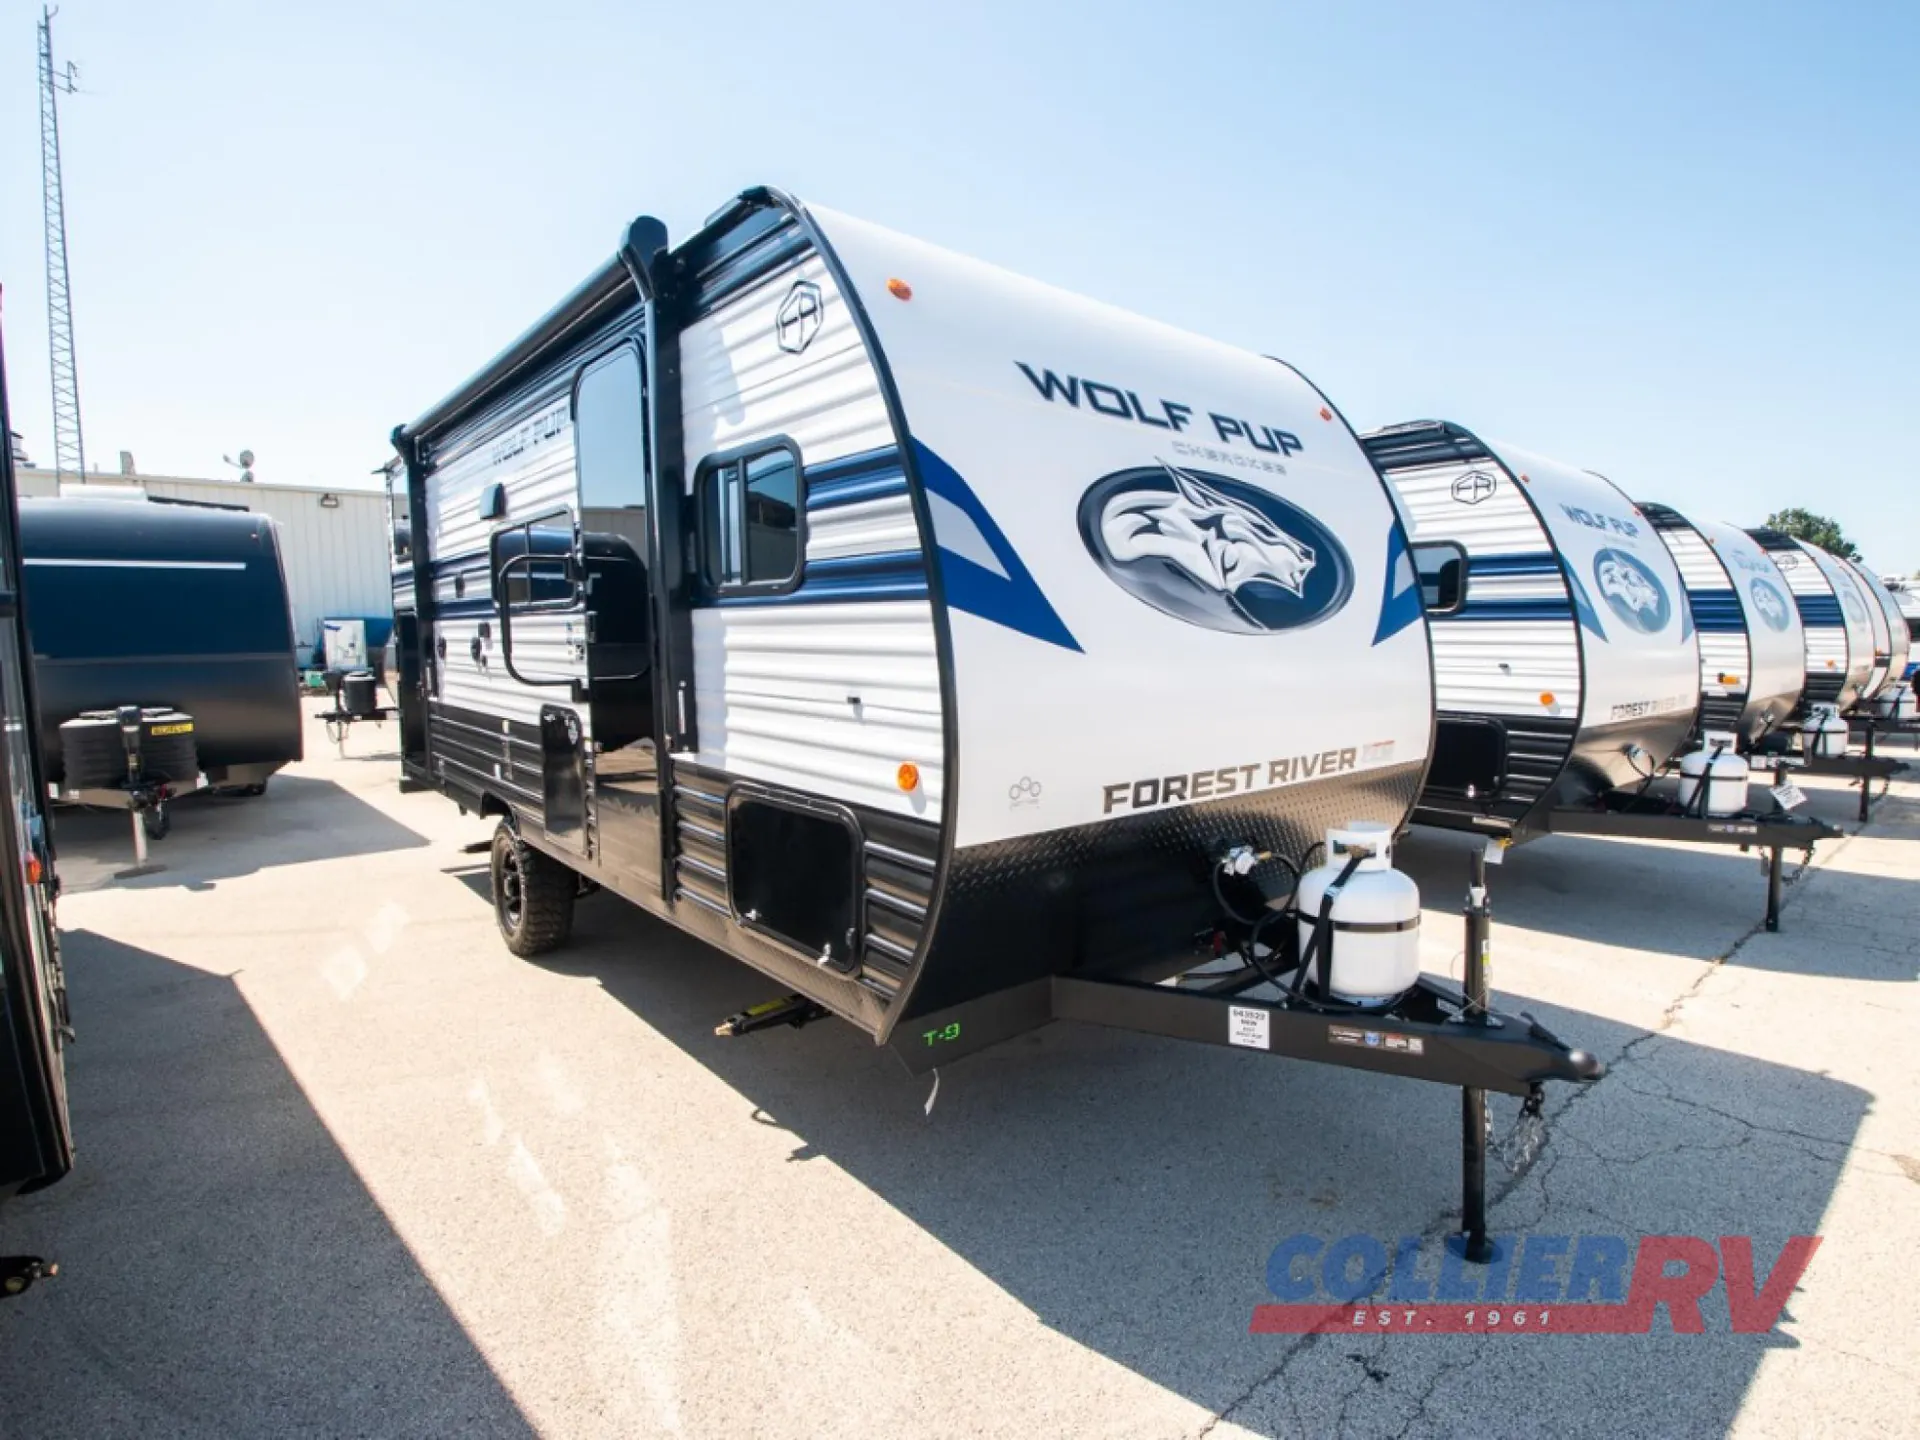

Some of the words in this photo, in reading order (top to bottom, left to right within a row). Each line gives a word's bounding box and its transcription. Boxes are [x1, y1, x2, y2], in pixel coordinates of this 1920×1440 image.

[1015, 360, 1193, 432] WOLF
[1208, 411, 1304, 457] PUP
[1560, 503, 1606, 530] WOLF
[1607, 516, 1639, 537] PUP
[1611, 700, 1650, 720] FOREST
[1102, 762, 1261, 815] FOREST
[1268, 747, 1357, 786] RIVER
